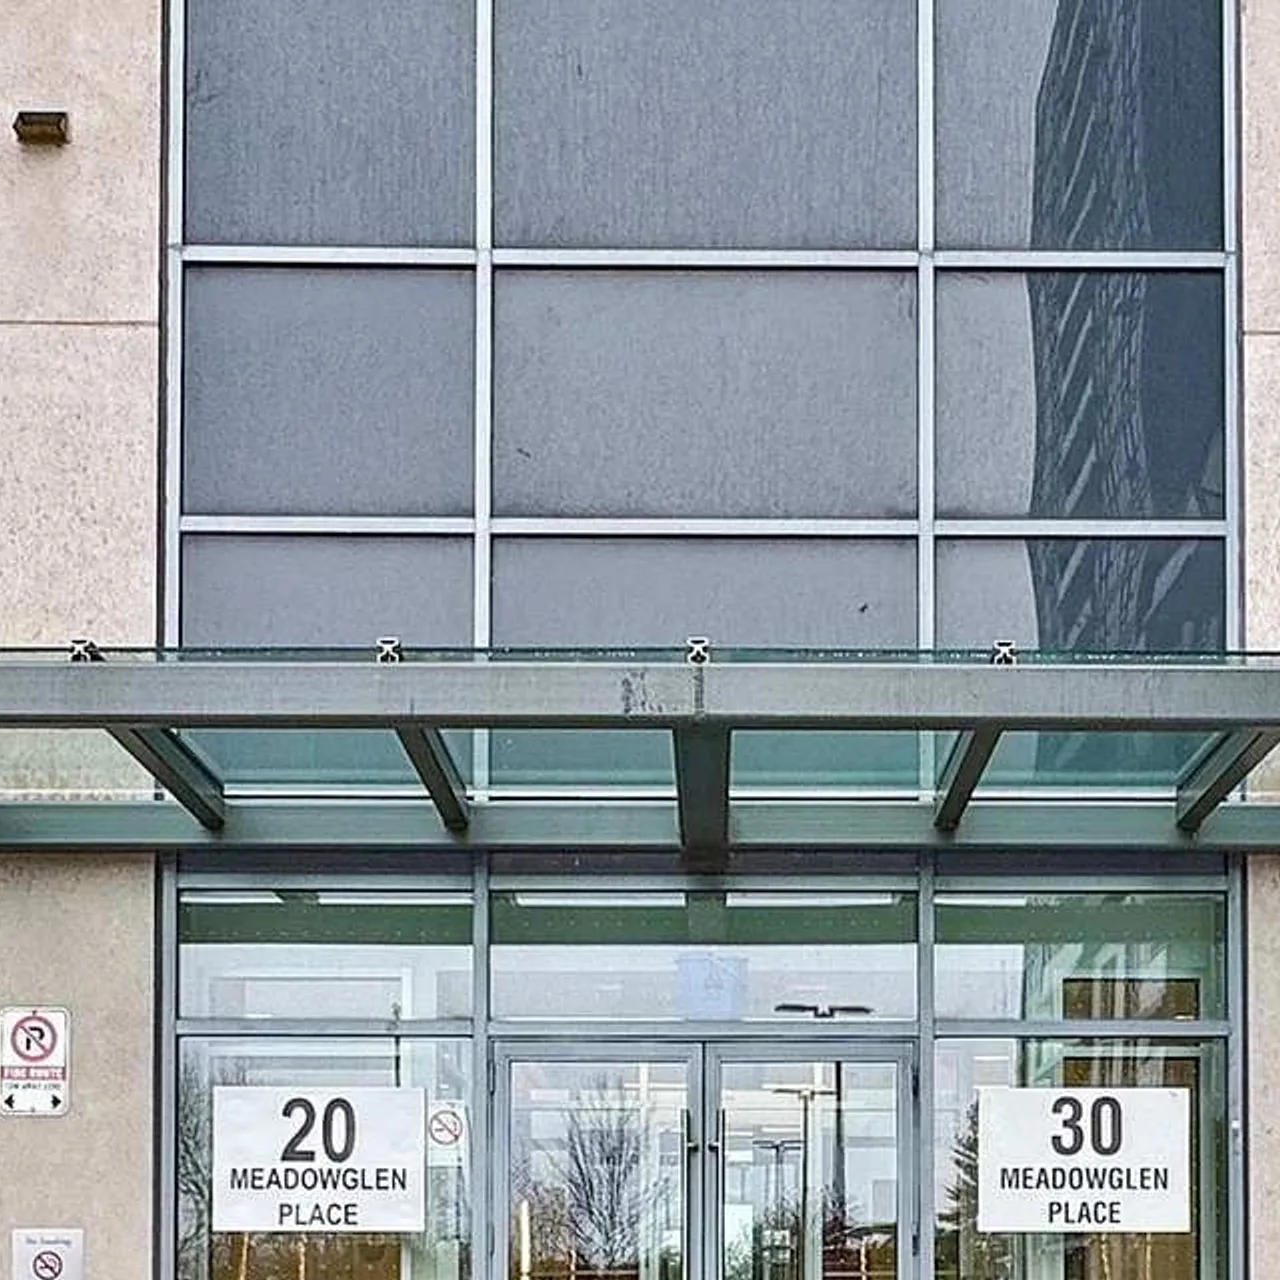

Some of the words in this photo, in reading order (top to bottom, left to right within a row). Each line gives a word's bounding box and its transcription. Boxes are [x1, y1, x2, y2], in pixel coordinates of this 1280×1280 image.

[281, 1097, 356, 1162] 20
[1051, 1096, 1122, 1156] 30
[230, 1167, 407, 1189] MEADOWGLEN
[1000, 1167, 1169, 1189] MEADOWGLEN
[279, 1203, 358, 1225] PLACE
[1048, 1201, 1121, 1223] PLACE
